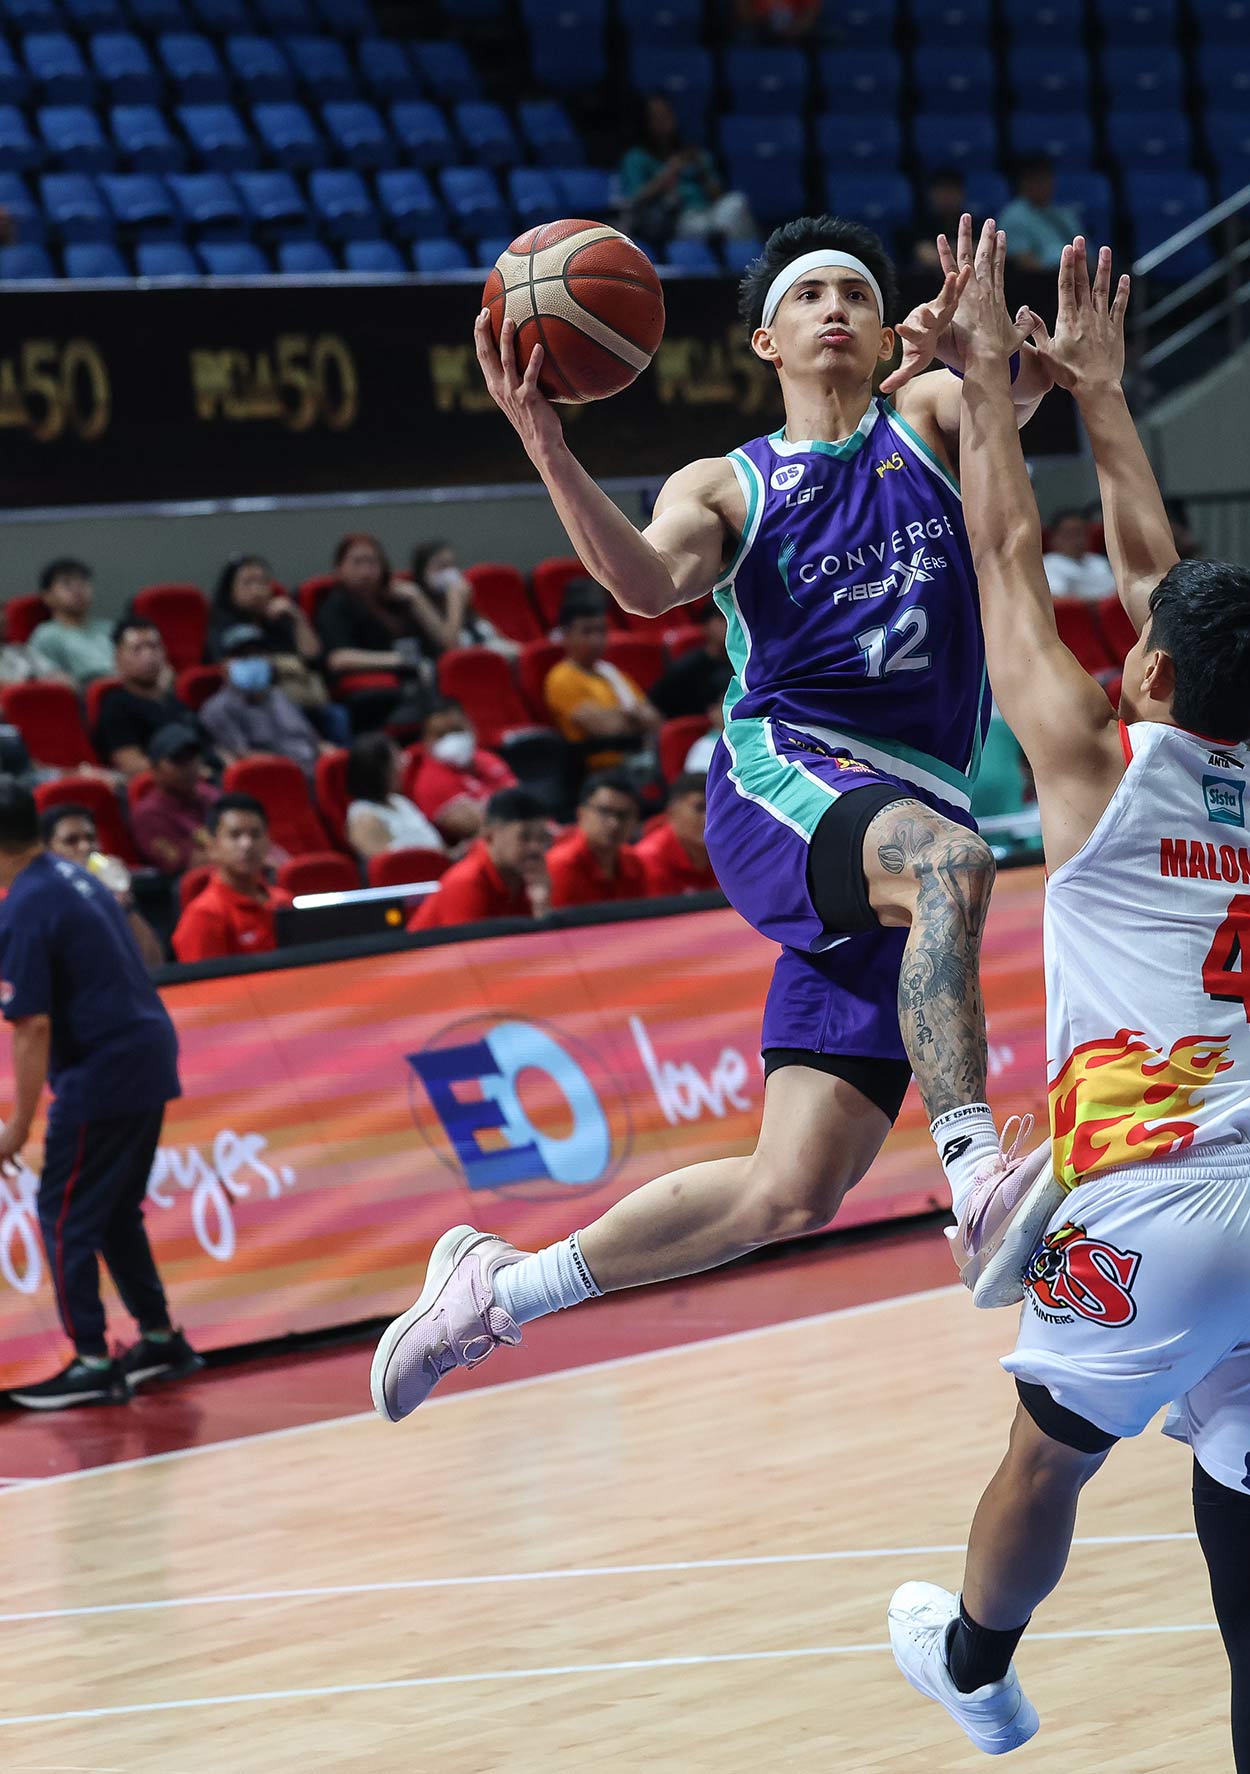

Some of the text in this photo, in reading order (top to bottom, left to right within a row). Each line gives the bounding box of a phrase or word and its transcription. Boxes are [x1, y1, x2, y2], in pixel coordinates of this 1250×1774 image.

[776, 466, 800, 486] DS
[853, 605, 933, 679] 12
[1208, 755, 1230, 769] ANTA
[1209, 788, 1237, 807] Sista
[629, 1015, 753, 1126] love
[146, 1128, 296, 1262] eyes.
